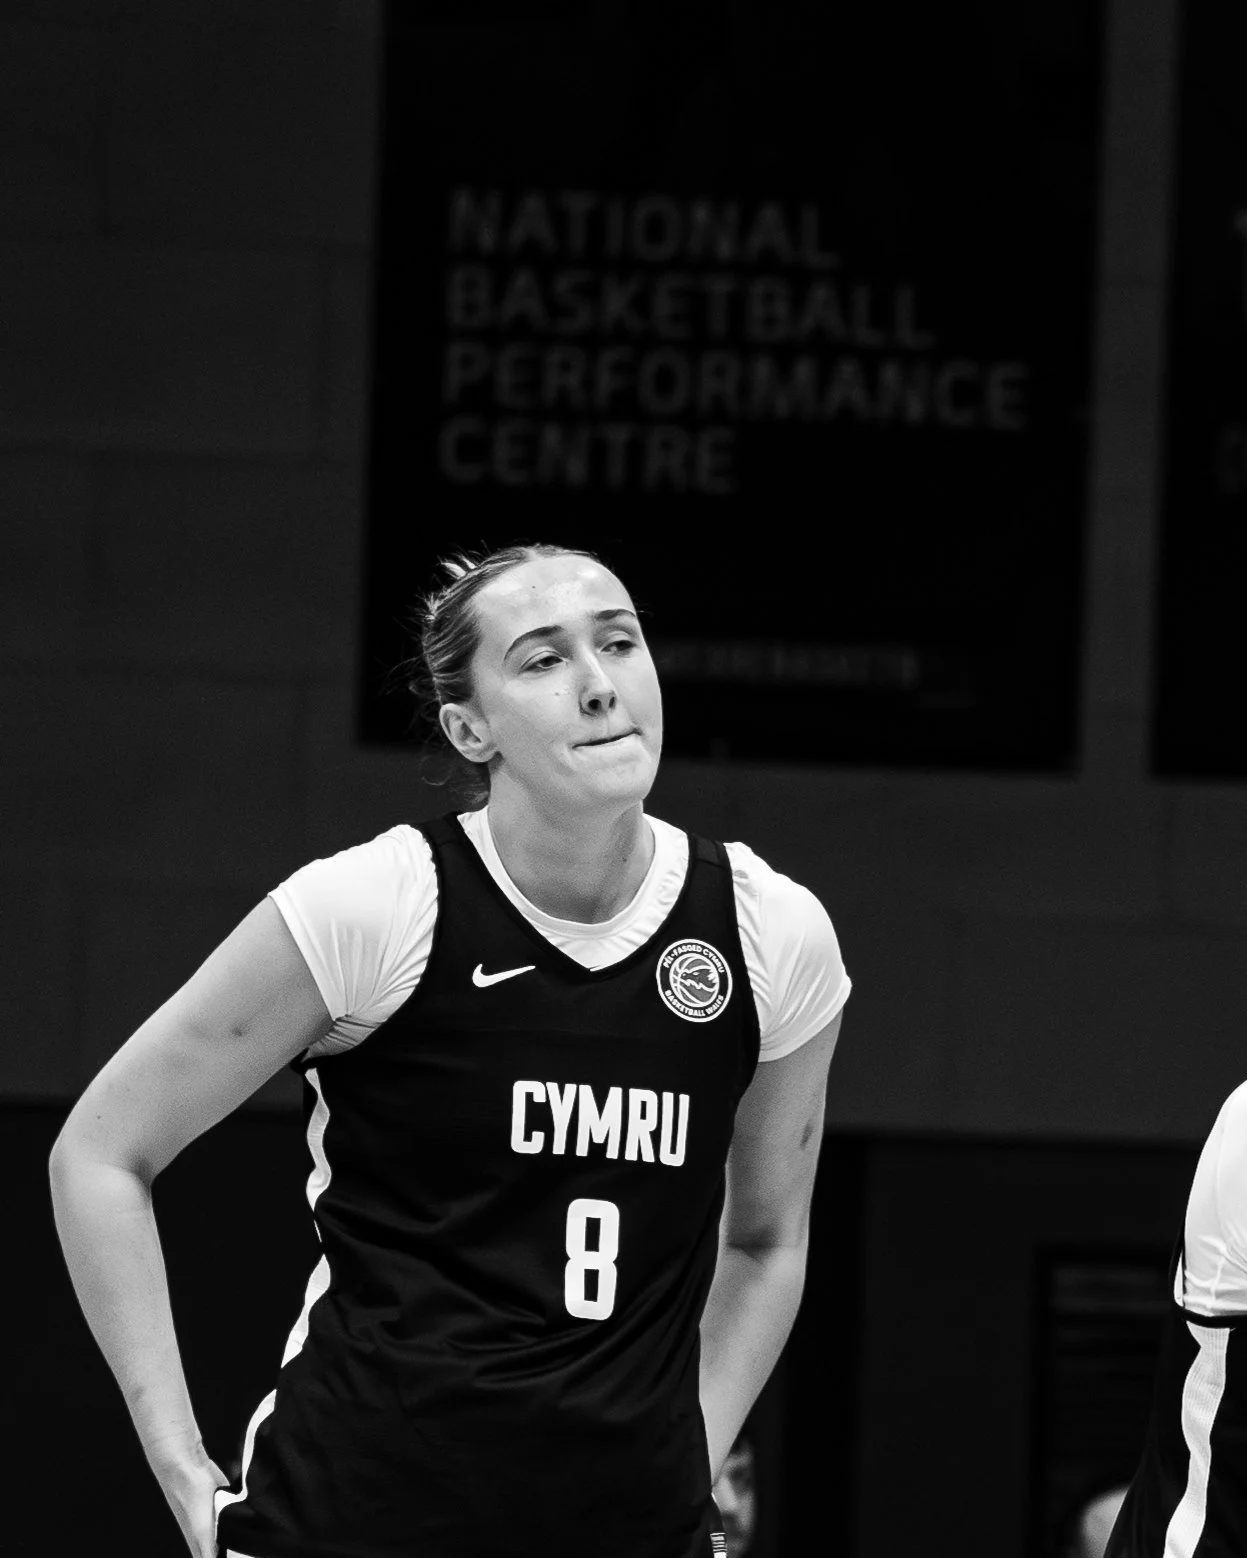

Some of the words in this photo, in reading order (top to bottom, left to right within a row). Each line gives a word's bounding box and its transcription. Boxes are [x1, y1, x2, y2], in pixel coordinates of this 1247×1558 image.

[448, 188, 842, 270] NATIONAL
[446, 266, 936, 349] BASKETBALL
[444, 344, 1028, 429] PERFORMANCE
[440, 417, 736, 493] CENTRE
[511, 1080, 690, 1167] CYMRU
[564, 1198, 620, 1321] 8
